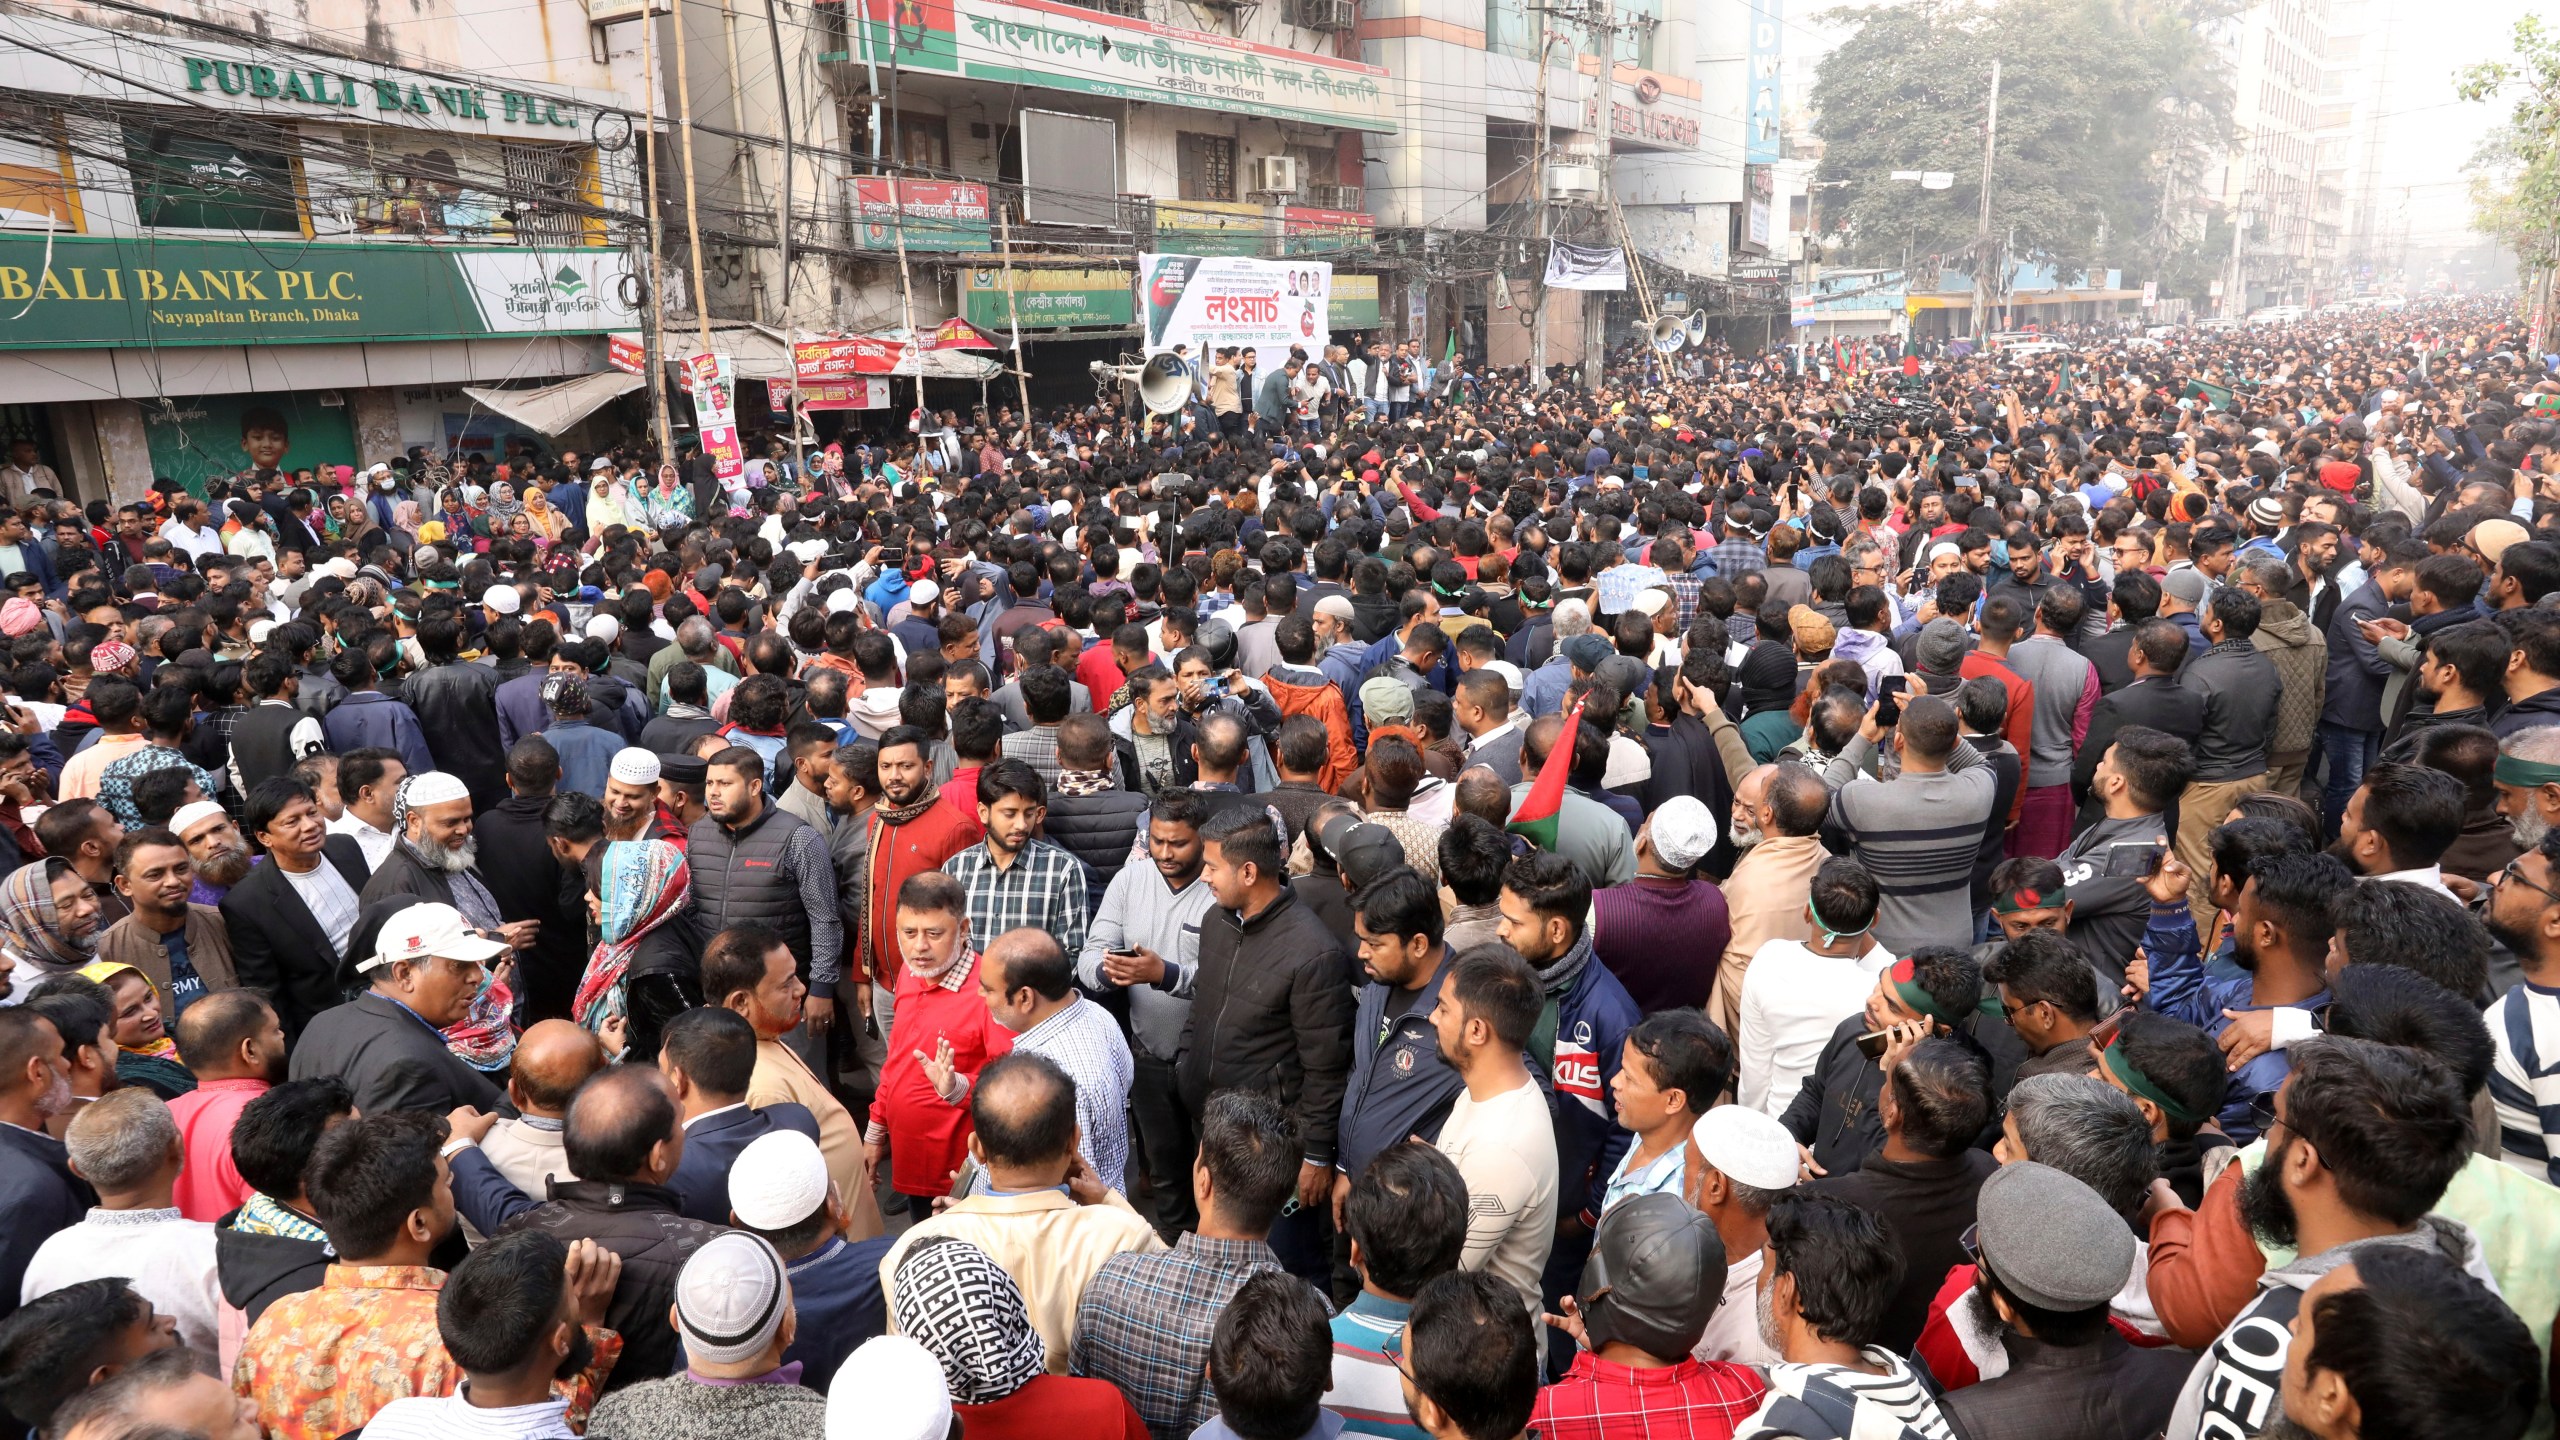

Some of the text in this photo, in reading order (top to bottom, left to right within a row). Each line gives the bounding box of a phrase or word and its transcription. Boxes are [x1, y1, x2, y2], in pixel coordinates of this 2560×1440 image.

[967, 14, 1380, 104] বাংলাদেশ জাতীয়তাবাদী দল-বিএনপি
[185, 57, 579, 128] PUBALI BANK PLC.
[1156, 75, 1265, 101] কেন্দ্রীয় কার্যালয়
[1583, 97, 1702, 146] HTEL VICTORY
[0, 265, 363, 302] BALI BANK PLC.
[1743, 268, 1780, 279] MIDWAY
[152, 307, 361, 328] Nayapaltan Branch, Dhaka
[1204, 290, 1280, 323] লংমার্চ
[1255, 333, 1266, 341] দল
[796, 343, 886, 360] সর্বনিম্ন ক্যাশ আউট
[798, 360, 855, 374] চার্জ নগদ-এ
[172, 976, 199, 995] RMY
